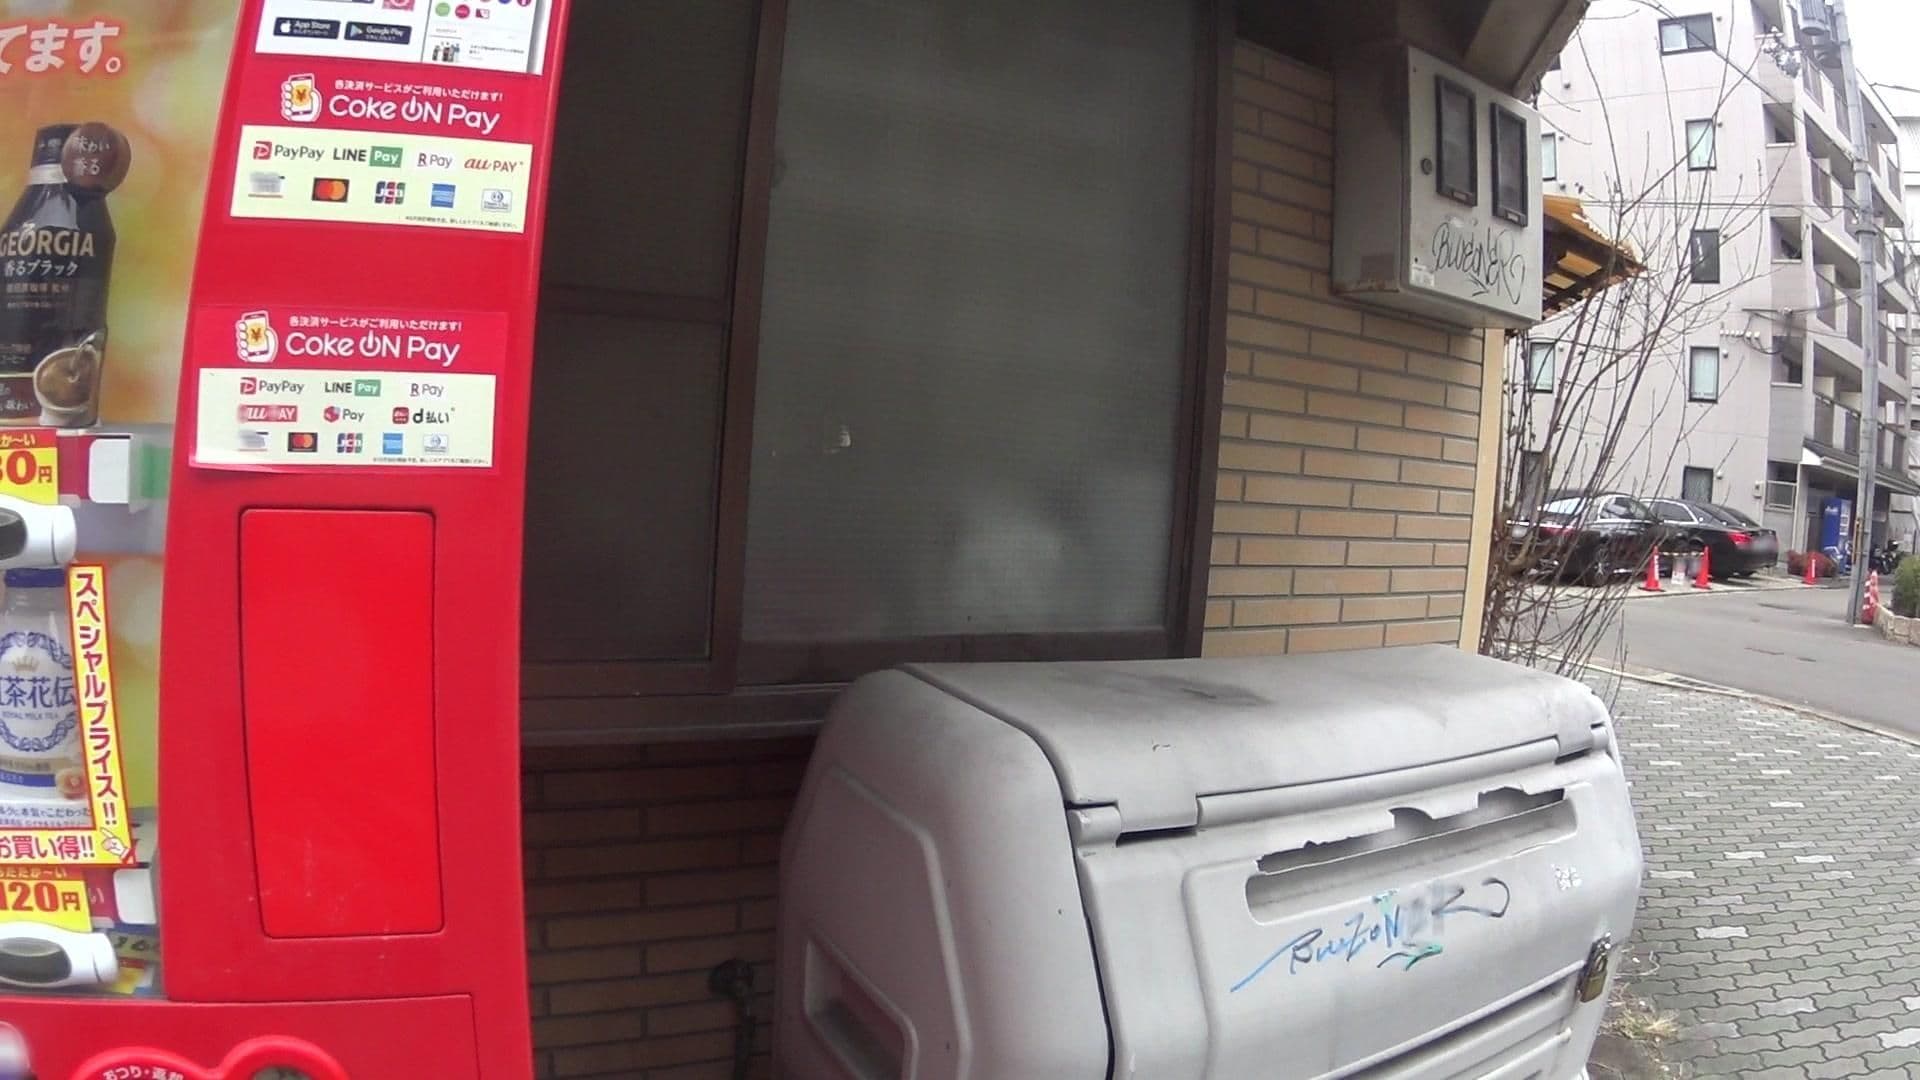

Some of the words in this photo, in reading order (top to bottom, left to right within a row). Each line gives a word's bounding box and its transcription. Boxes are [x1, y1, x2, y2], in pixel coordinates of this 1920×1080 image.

[329, 95, 397, 121] Coke
[401, 95, 441, 124] ON
[447, 103, 500, 135] Pay
[274, 144, 325, 162] PayPay
[333, 148, 367, 163] LINE
[373, 149, 400, 165] Pay
[429, 152, 452, 169] Pay
[464, 158, 492, 171] au
[493, 160, 518, 173] PAY
[0, 229, 95, 257] GEORGIA
[4, 258, 79, 277] 香るブラック
[285, 332, 355, 357] Coke
[359, 330, 401, 359] ON
[407, 336, 461, 367] Pay
[258, 379, 304, 395] PayPay
[324, 381, 352, 394] LINE
[357, 383, 379, 396] Pay
[422, 383, 444, 397] Pay
[342, 407, 365, 423] Pay
[412, 404, 450, 424] d払い
